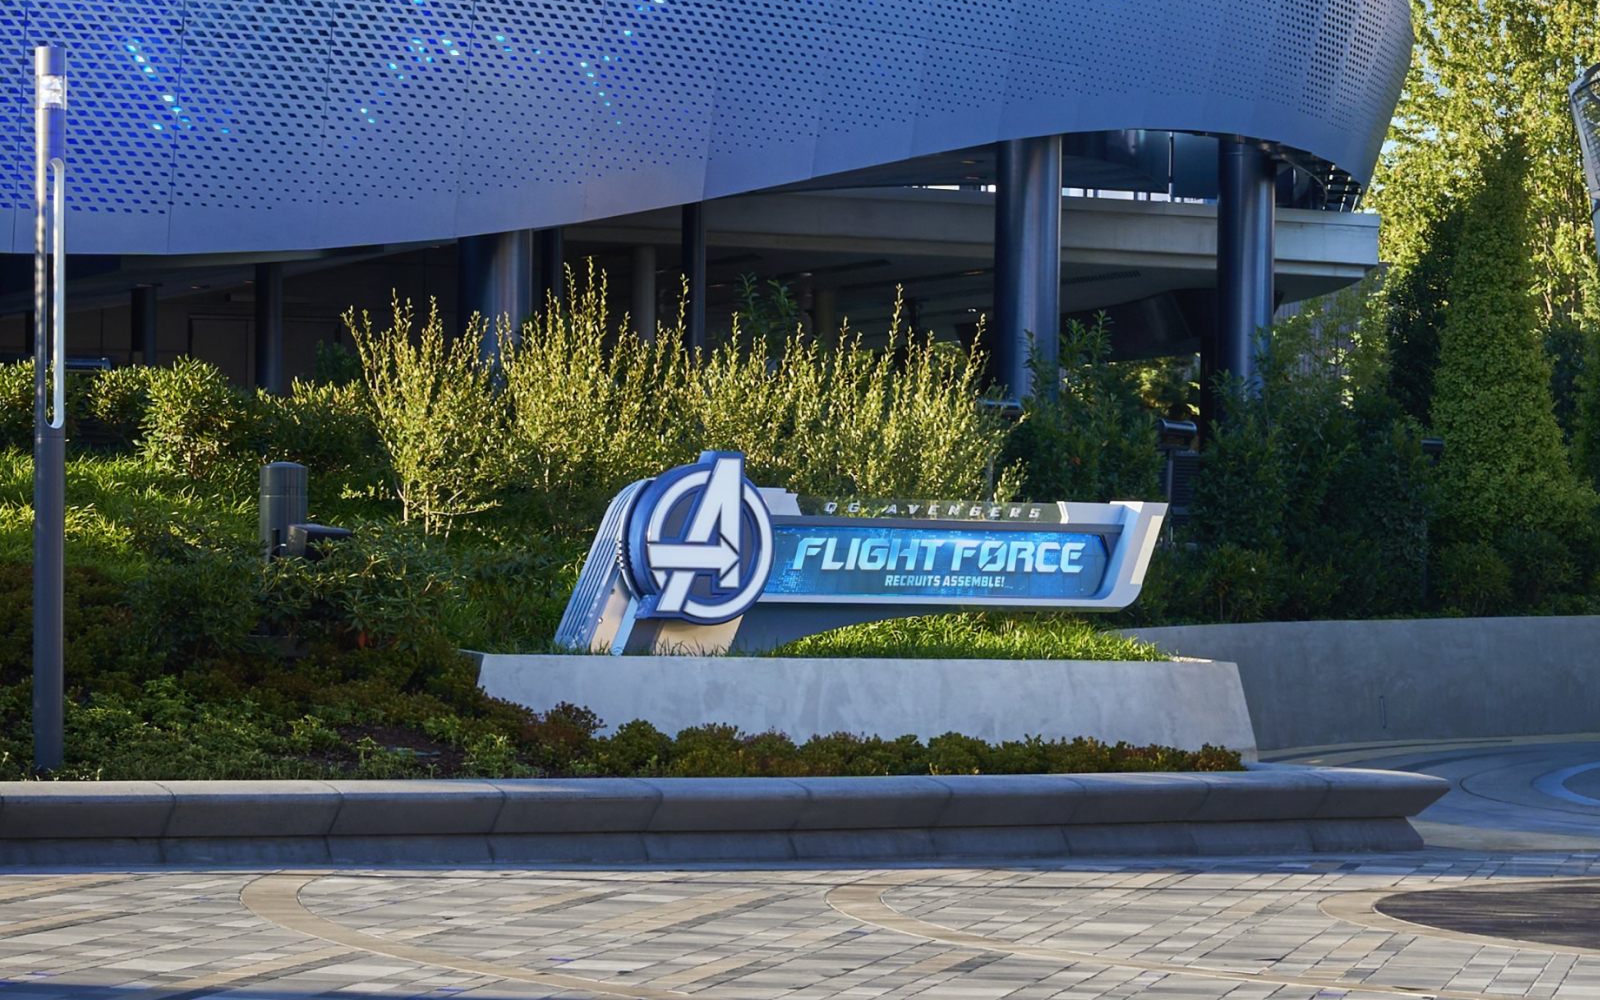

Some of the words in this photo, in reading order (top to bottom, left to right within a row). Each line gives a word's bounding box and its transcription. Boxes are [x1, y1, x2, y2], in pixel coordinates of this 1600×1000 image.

[824, 501, 861, 515] QG
[886, 503, 1042, 519] AVENGERS
[791, 537, 947, 571] FLIGHT
[950, 540, 1086, 574] FORCE
[884, 575, 941, 587] RECRUITS
[942, 575, 1006, 588] ASSEMBLE!
